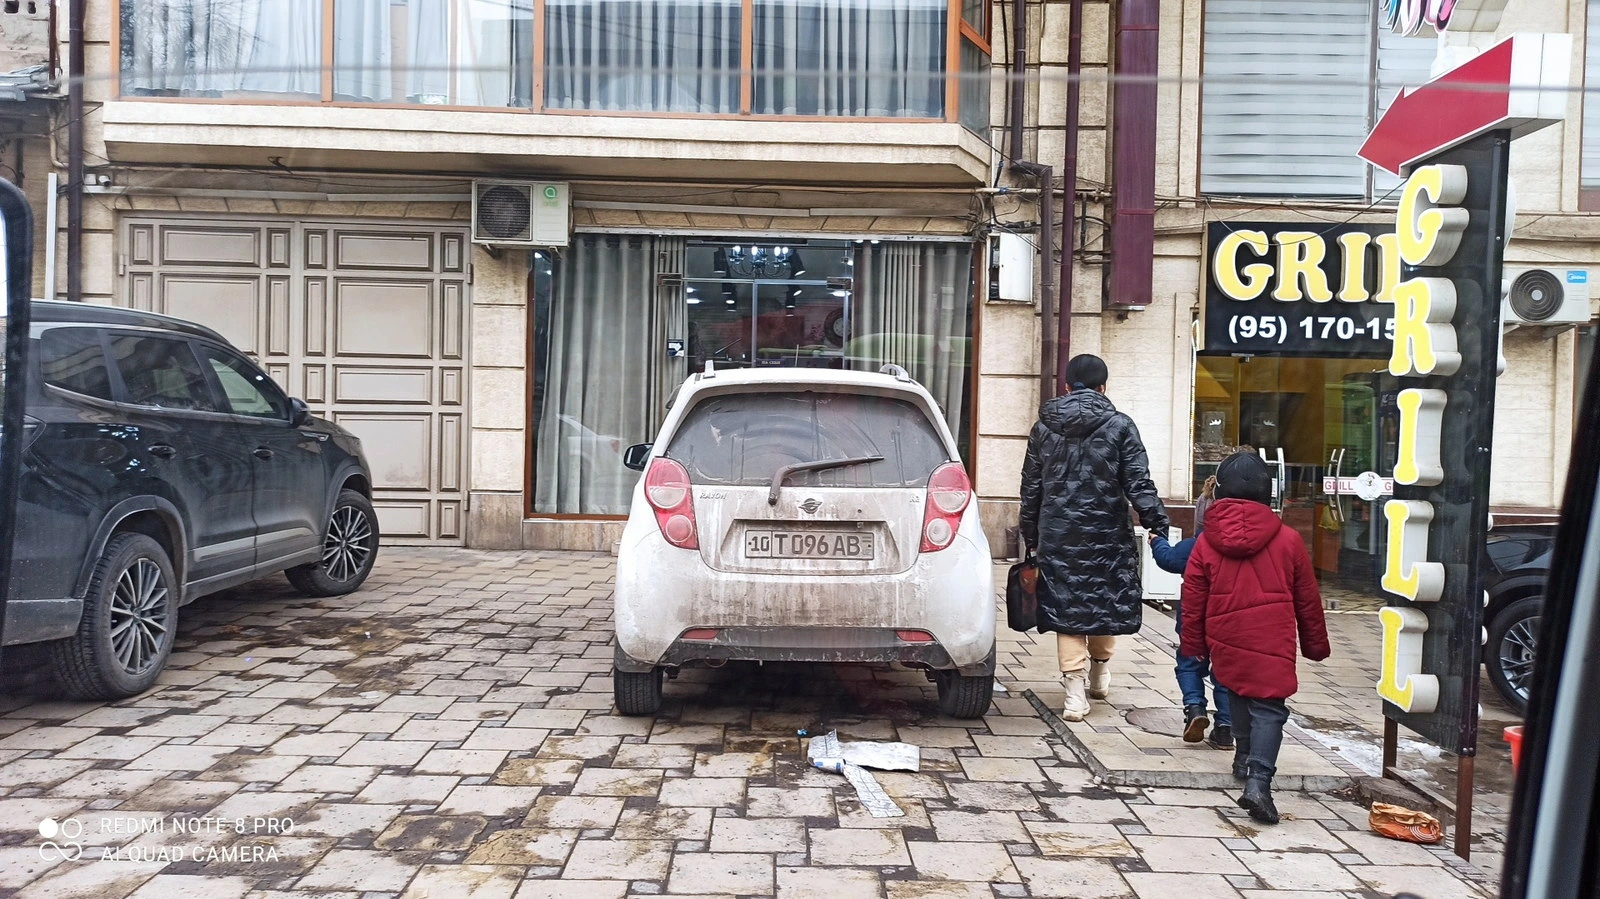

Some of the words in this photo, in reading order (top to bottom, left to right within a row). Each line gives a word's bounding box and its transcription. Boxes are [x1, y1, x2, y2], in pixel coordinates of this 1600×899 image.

[1228, 315, 1288, 344] (95)
[1376, 164, 1468, 712] GRILL
[750, 536, 770, 552] 10
